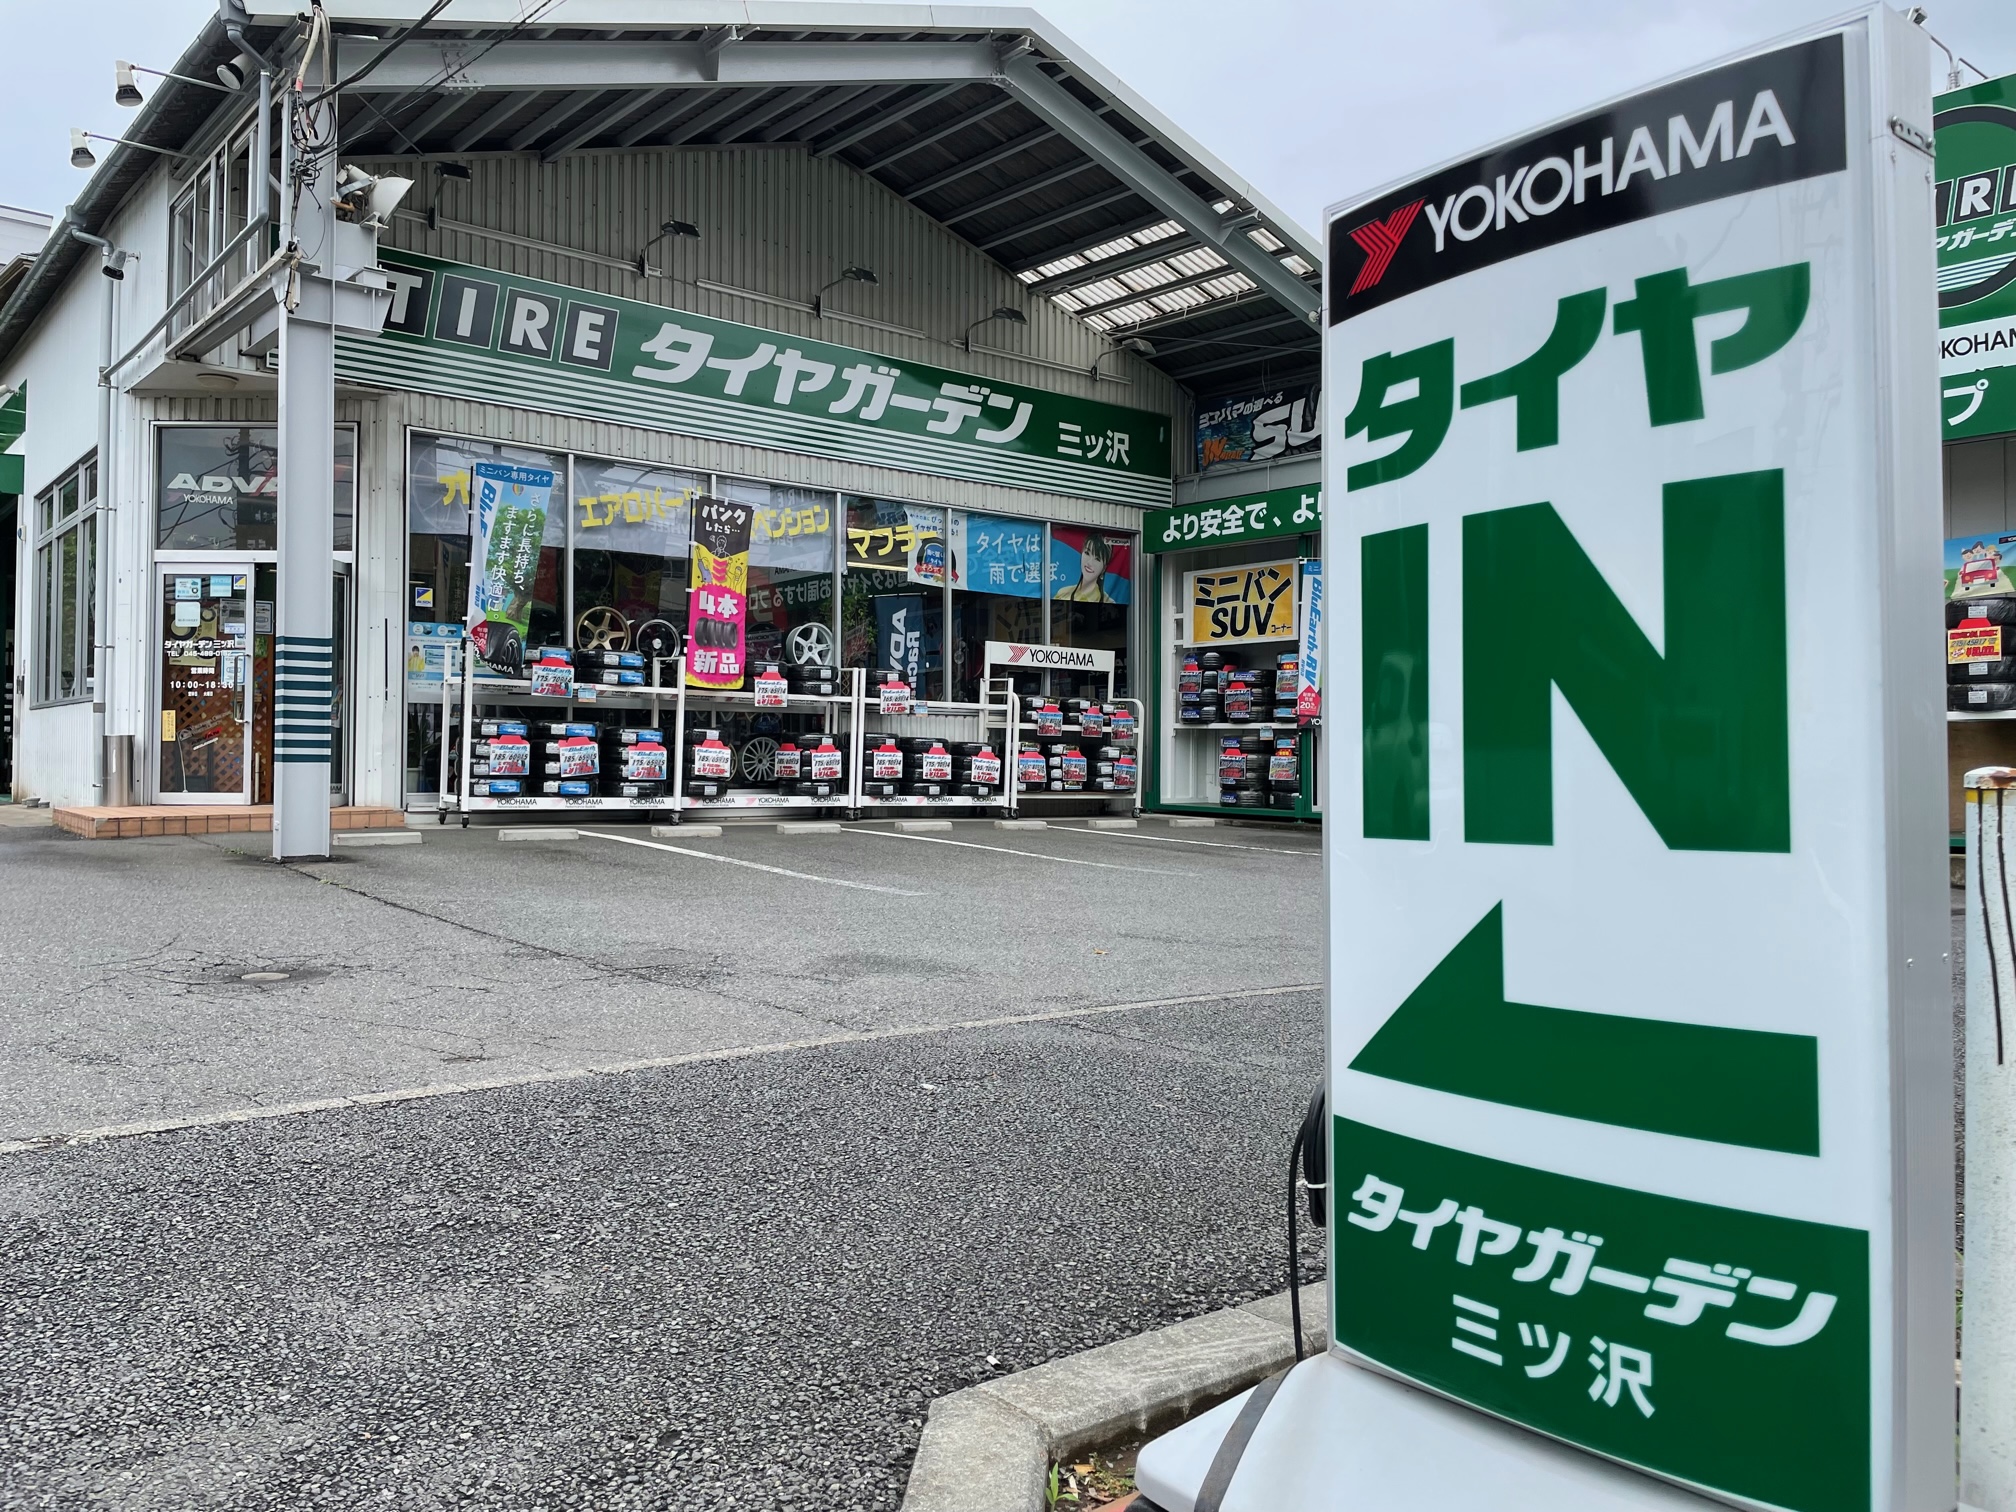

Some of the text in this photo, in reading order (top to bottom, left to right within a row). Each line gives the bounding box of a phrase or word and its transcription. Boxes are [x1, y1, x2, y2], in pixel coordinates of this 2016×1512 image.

[1424, 89, 1796, 253] YOKOHAMA
[387, 271, 605, 361] TIRE
[1939, 328, 2016, 360] KOHA
[1345, 261, 1810, 492] タイヤ
[632, 322, 1131, 466] タイヤガーデン 三ツ沢
[480, 465, 550, 484] ミニバン専用タイヤ
[183, 494, 234, 504] YOKOHAMA
[702, 504, 746, 526] パンク
[750, 505, 829, 539] ペンション
[512, 492, 541, 591] さらに長持ち、
[848, 524, 938, 558] マフラー
[976, 531, 1041, 554] タイヤは
[486, 506, 519, 619] ますます快適に。
[1195, 567, 1292, 608] ミニバン
[699, 591, 739, 619] 4本
[1210, 602, 1275, 638] SUV
[164, 640, 212, 649] タイヤガーデン
[1271, 623, 1292, 633] コーナー
[693, 649, 740, 674] 新品
[1030, 649, 1094, 667] YOKOHAMA
[1361, 468, 1791, 853] IN
[497, 798, 537, 806] YOKOHAMA
[565, 798, 603, 806] YOKOHAMA
[1347, 1174, 1838, 1347] タイヤガーデン
[1451, 1294, 1655, 1418] 三ツ沢
